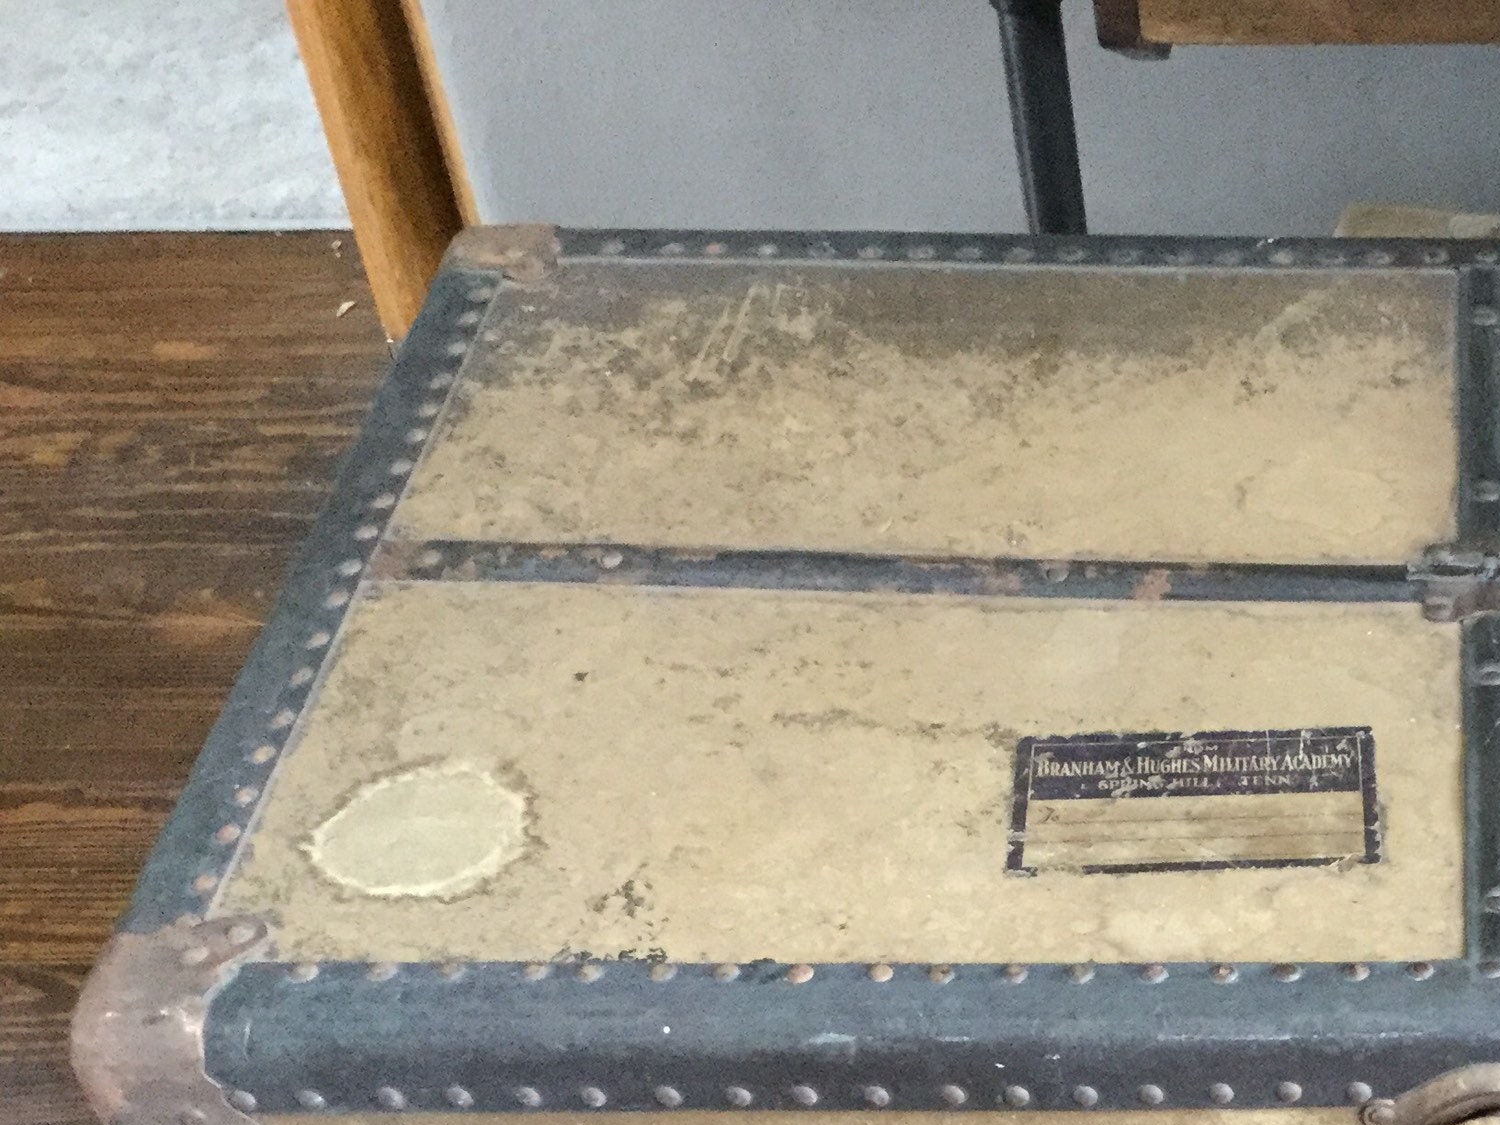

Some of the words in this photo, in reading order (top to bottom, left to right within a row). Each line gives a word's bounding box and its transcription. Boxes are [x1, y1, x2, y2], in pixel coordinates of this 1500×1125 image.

[1037, 758, 1121, 778] BRANHAM
[1120, 756, 1133, 777] &
[1136, 756, 1201, 774] HUGHES
[1203, 753, 1282, 773] MILITARY
[1281, 753, 1353, 771] ACADEMY
